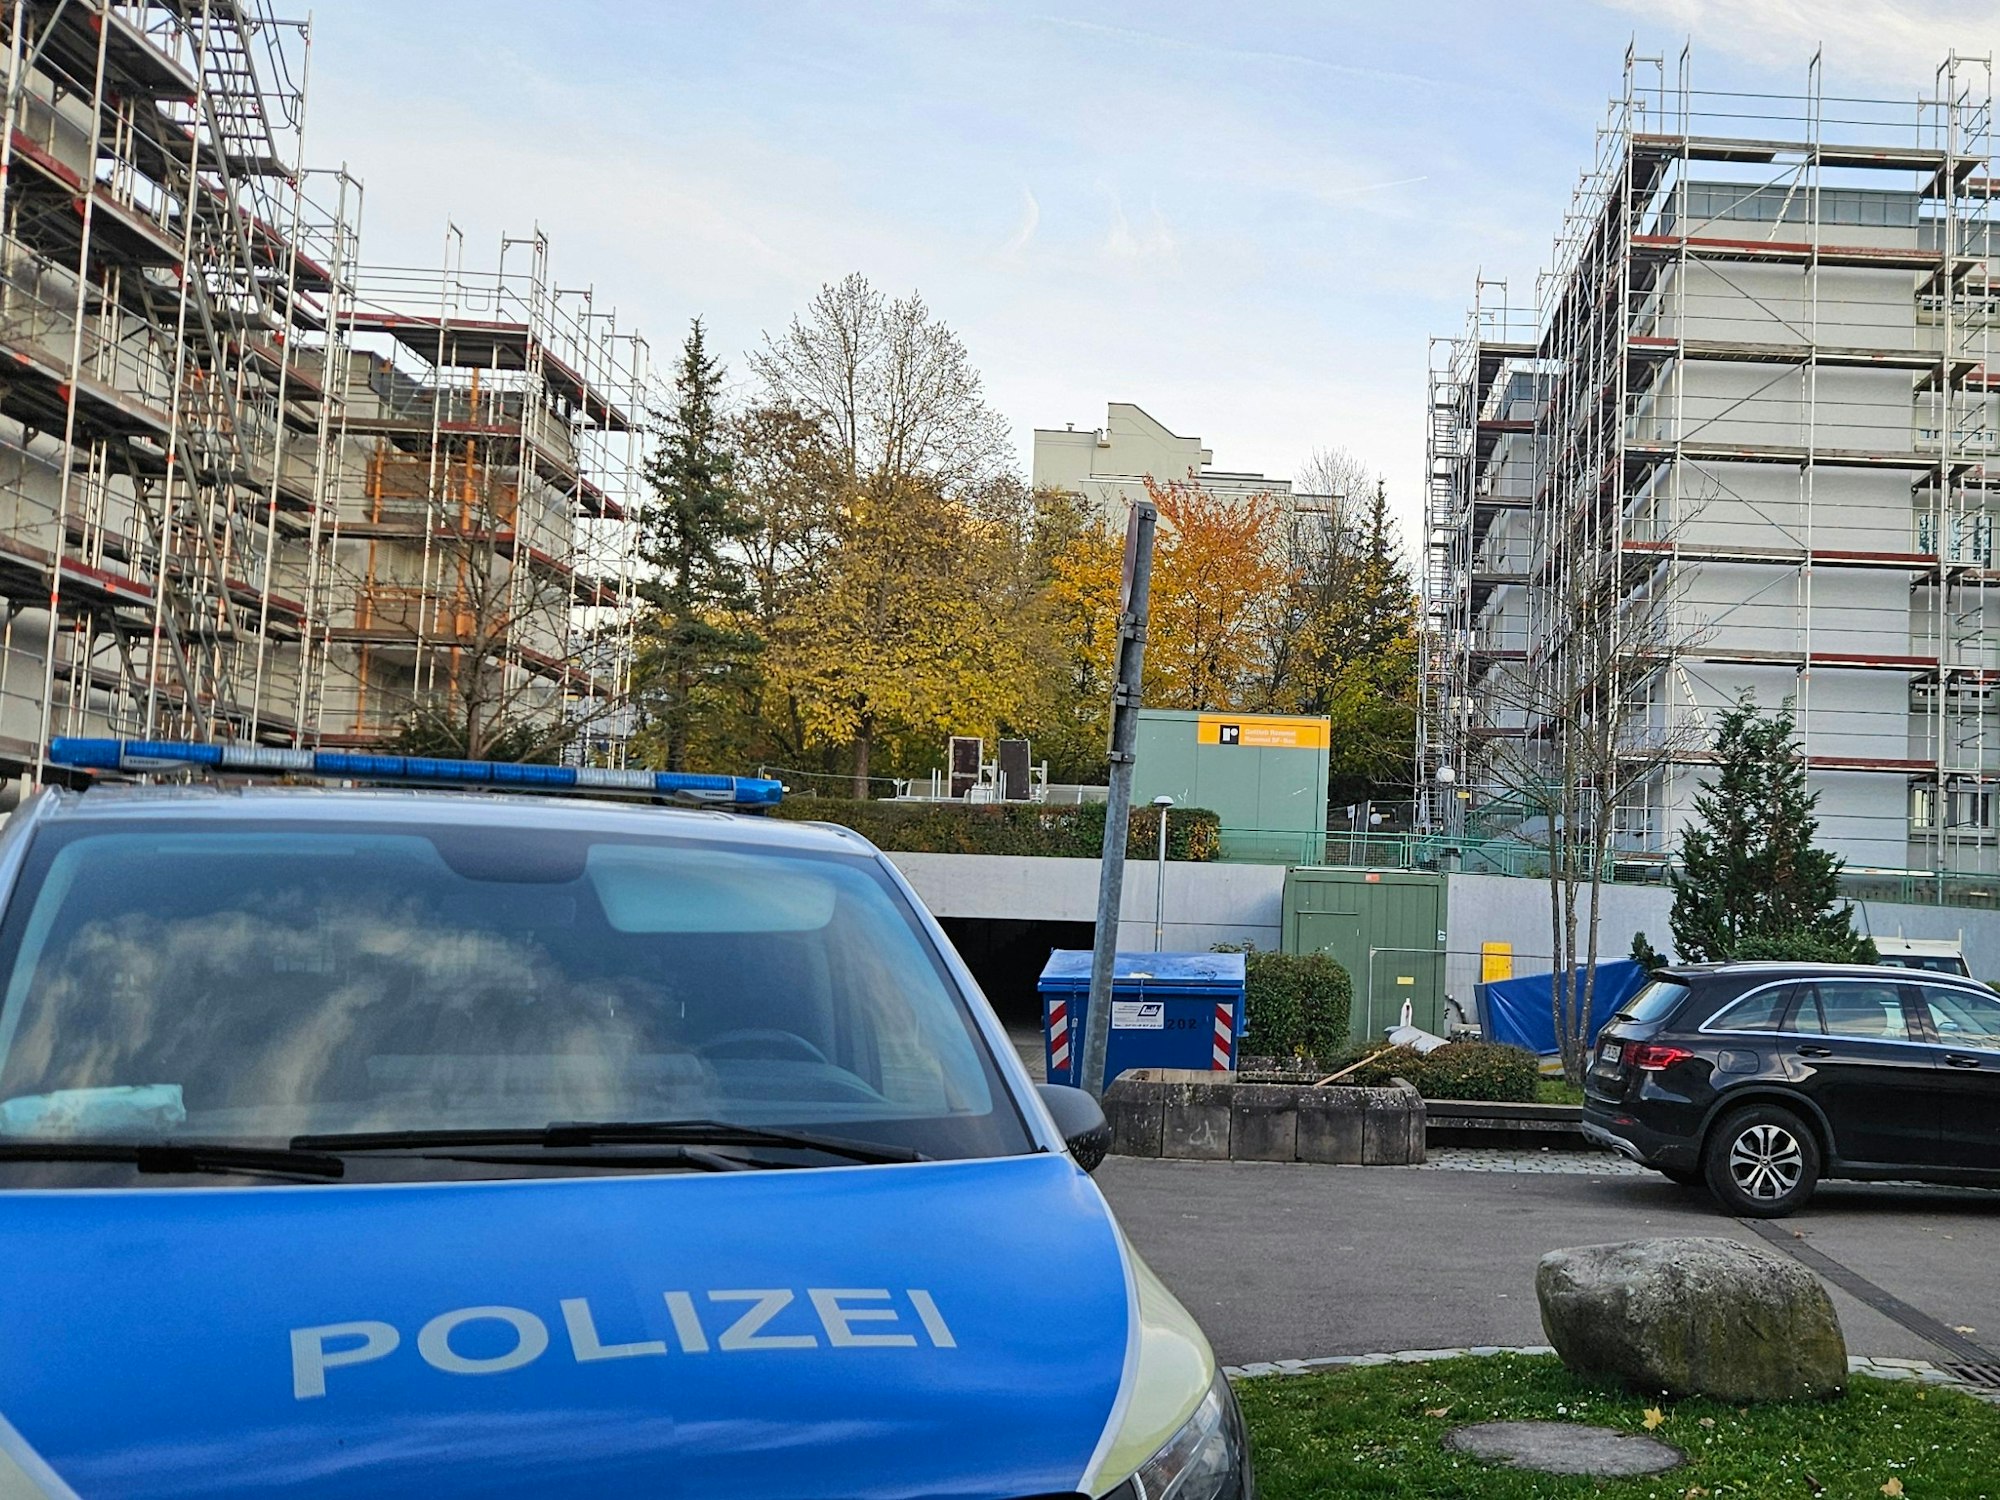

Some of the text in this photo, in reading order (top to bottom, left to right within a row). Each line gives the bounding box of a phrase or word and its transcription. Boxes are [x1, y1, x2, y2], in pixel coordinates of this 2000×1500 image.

[1437, 929, 1446, 941] 07
[1167, 1018, 1197, 1030] 202
[290, 1288, 957, 1398] POLIZEI
